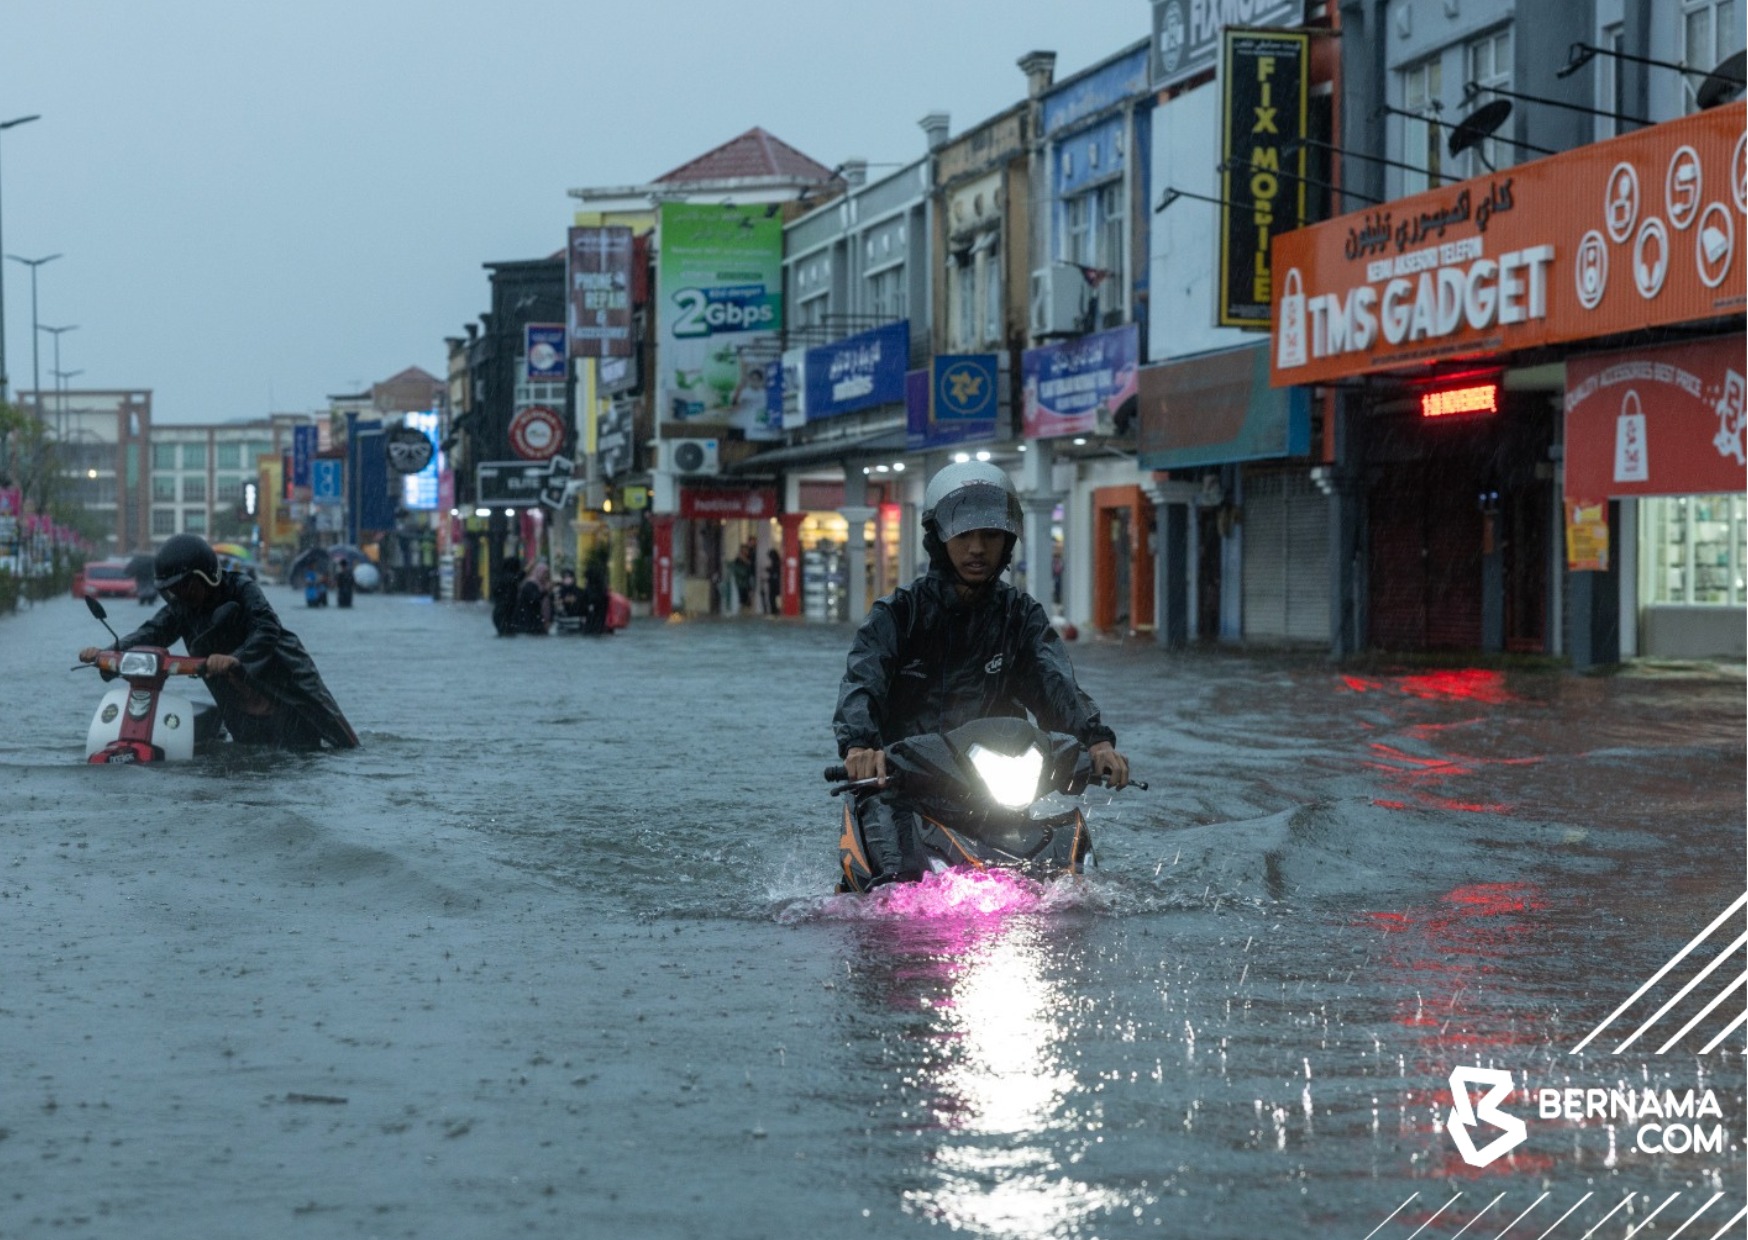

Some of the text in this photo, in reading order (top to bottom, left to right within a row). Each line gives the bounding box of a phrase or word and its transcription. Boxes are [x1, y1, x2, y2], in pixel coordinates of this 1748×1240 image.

[1253, 56, 1279, 134] FIX
[1251, 146, 1280, 303] MOBILE
[1308, 286, 1378, 359] TMS
[1381, 244, 1555, 344] GADGET
